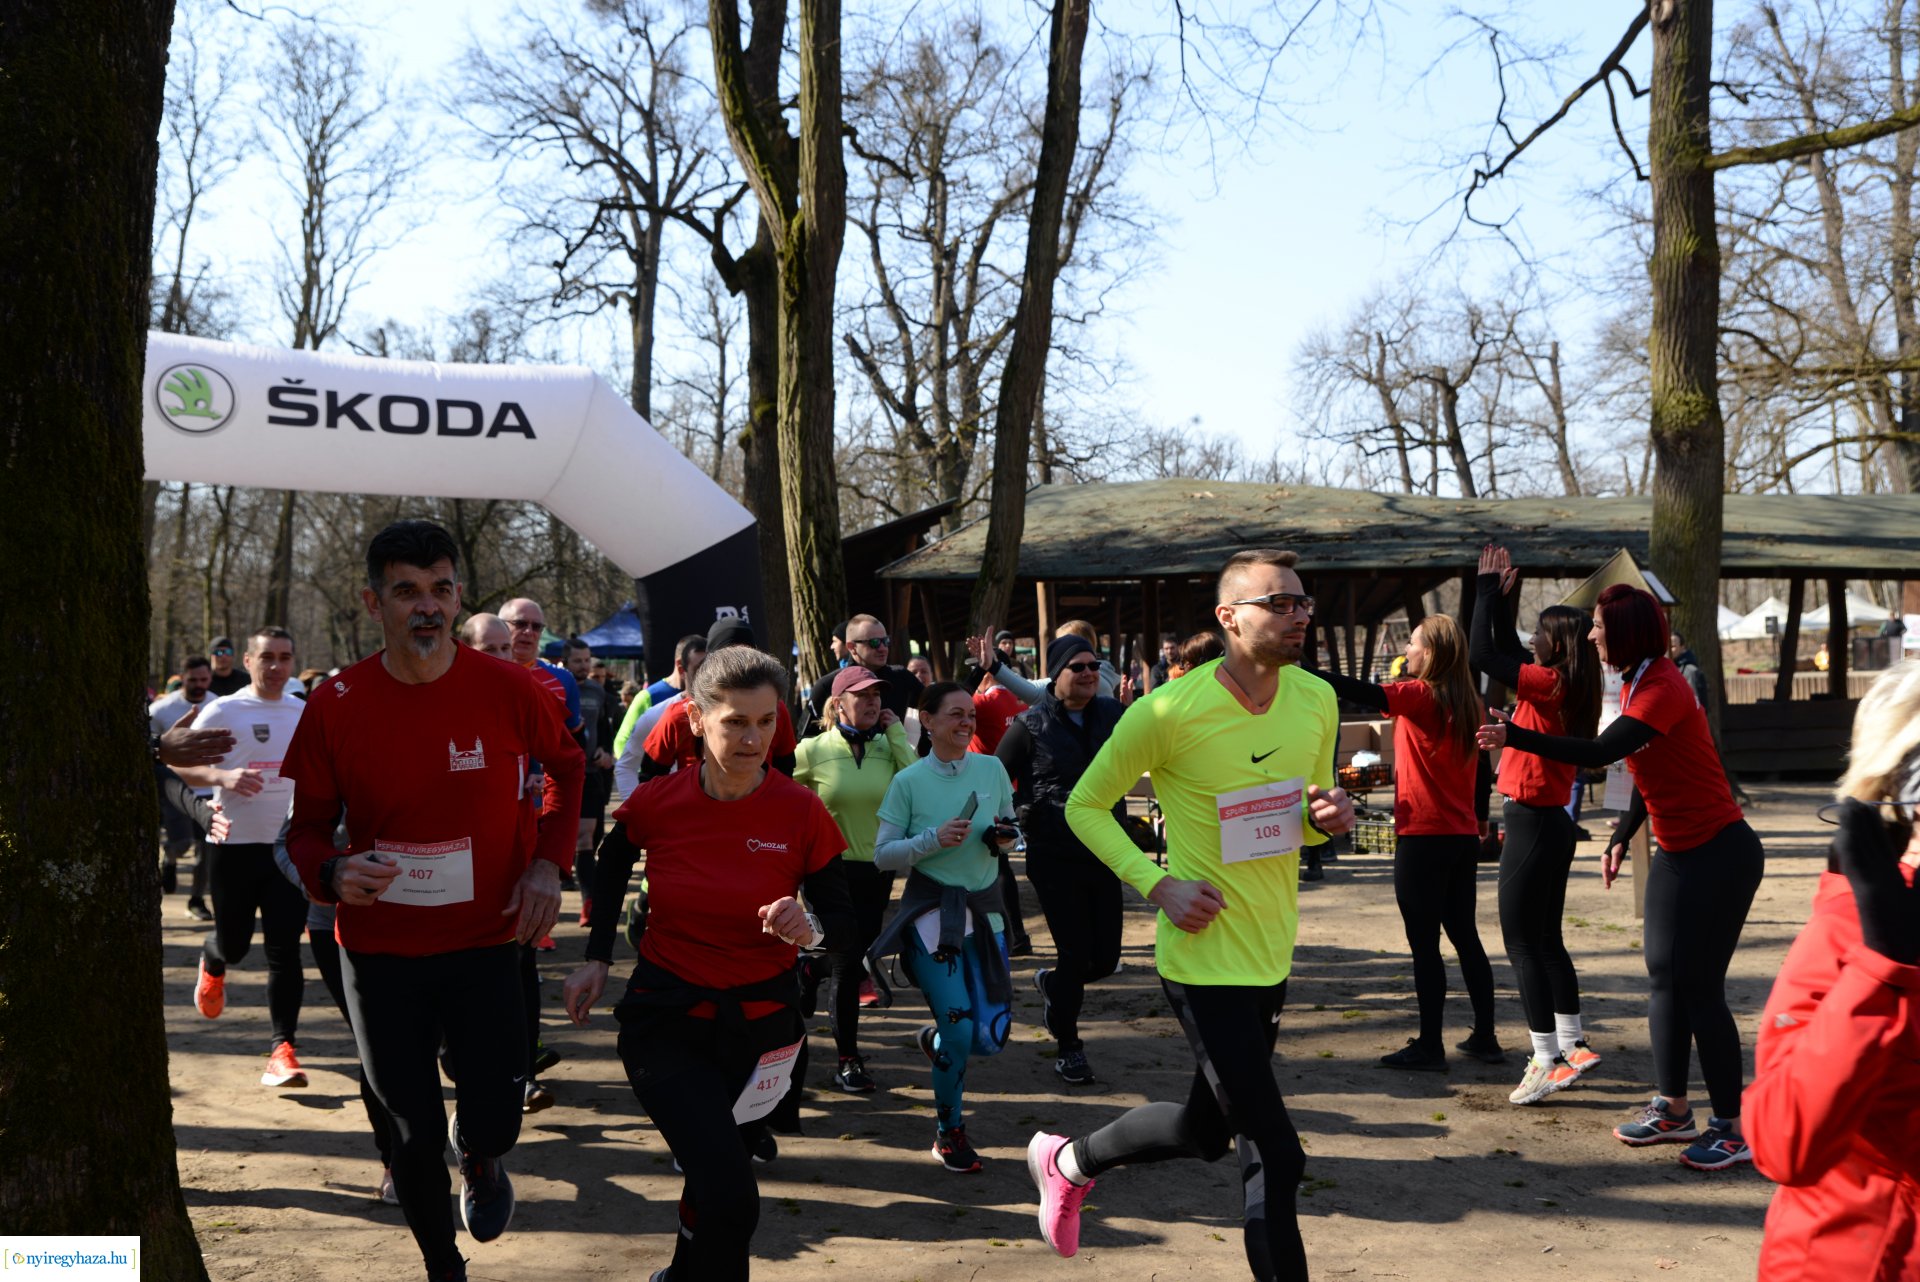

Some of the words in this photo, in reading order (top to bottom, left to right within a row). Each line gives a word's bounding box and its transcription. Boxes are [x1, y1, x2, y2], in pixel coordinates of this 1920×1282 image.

[267, 377, 537, 440] ŠKODA
[1254, 824, 1281, 840] 108
[760, 842, 787, 850] MOZAIK
[408, 869, 433, 880] 407
[757, 1075, 779, 1091] 417
